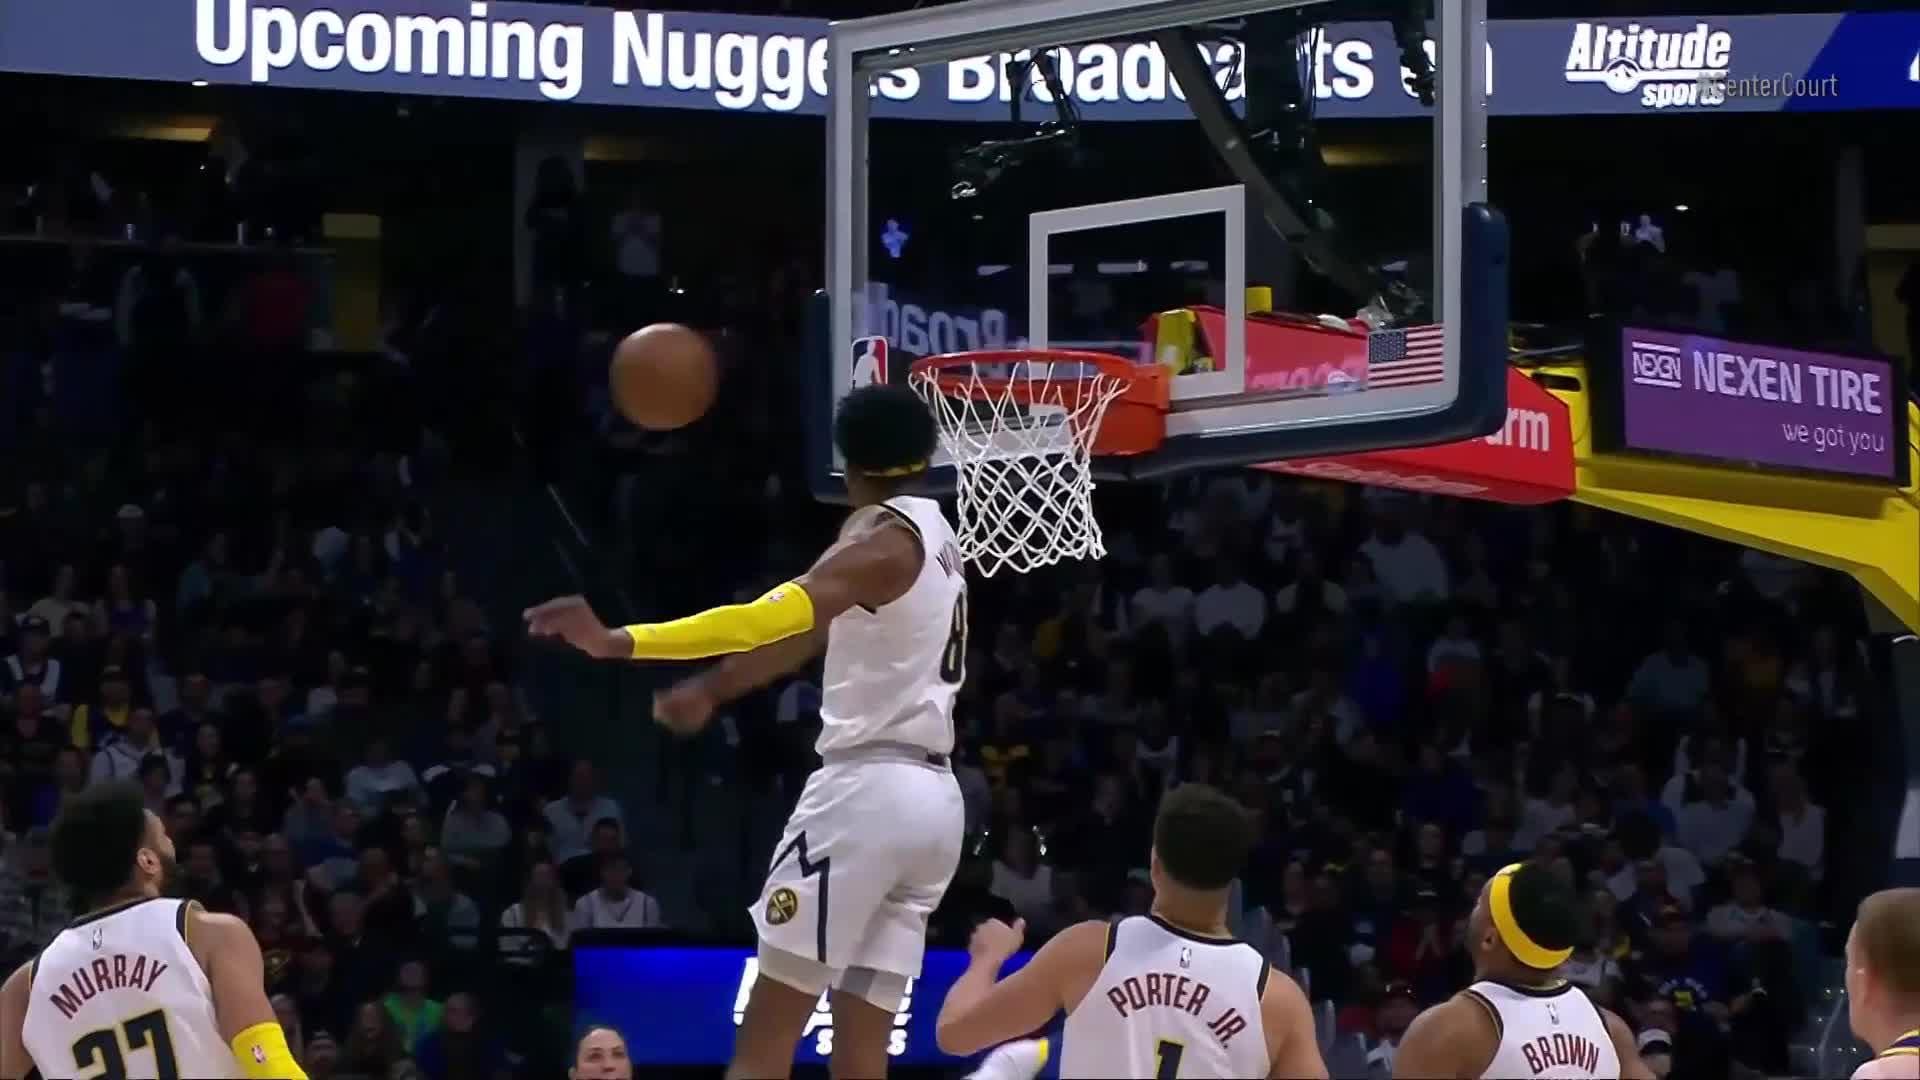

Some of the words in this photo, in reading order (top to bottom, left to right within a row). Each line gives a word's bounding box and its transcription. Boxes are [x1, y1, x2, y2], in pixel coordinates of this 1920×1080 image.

[196, 0, 585, 100] Upcoming
[1565, 22, 1732, 70] Altitude
[1641, 79, 1727, 108] sports
[1693, 350, 1802, 404] NEXEN
[1808, 365, 1883, 415] TIRE
[1782, 422, 1809, 443] we
[1815, 425, 1845, 453] got
[1850, 432, 1885, 456] you
[49, 953, 168, 1020] MURRAY
[1106, 971, 1211, 1019] PORTER
[1206, 1006, 1248, 1050] JR.
[1520, 1032, 1600, 1076] BROWN
